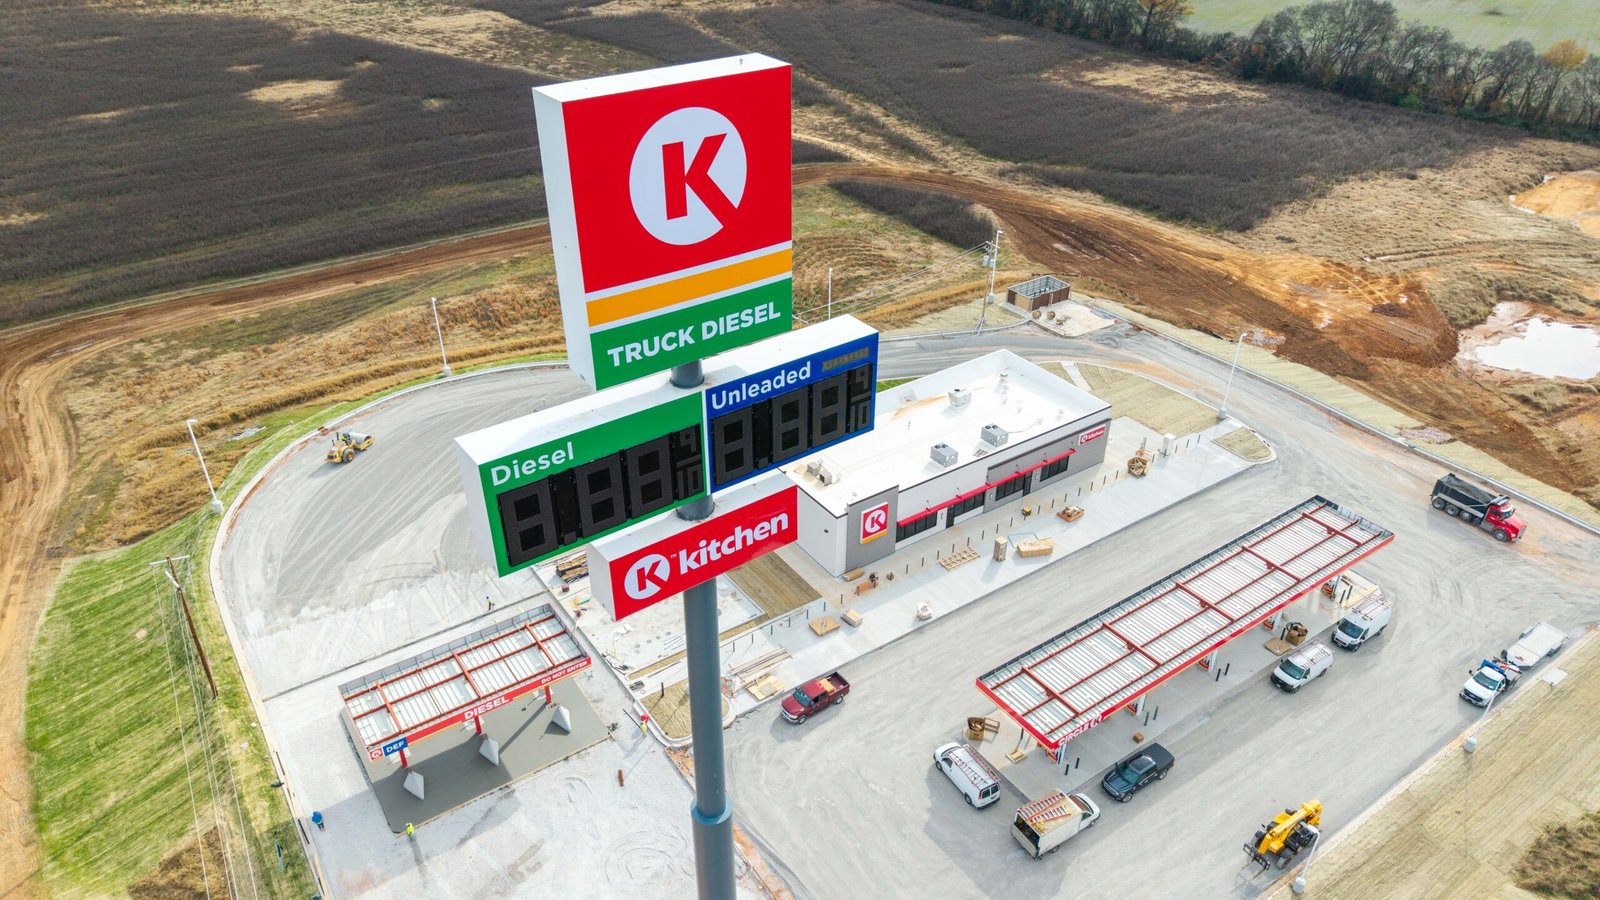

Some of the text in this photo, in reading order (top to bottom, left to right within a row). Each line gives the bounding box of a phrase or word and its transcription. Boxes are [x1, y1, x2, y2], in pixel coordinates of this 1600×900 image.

[607, 301, 781, 367] TRUCK DIESEL
[711, 361, 811, 409] Unleaded
[491, 441, 574, 486] Diesel
[679, 513, 788, 575] kitchen
[541, 660, 588, 684] DO NOT ENTER
[464, 696, 510, 720] DIESEL
[386, 740, 404, 753] DEF
[1058, 721, 1090, 746] CIRCLE
